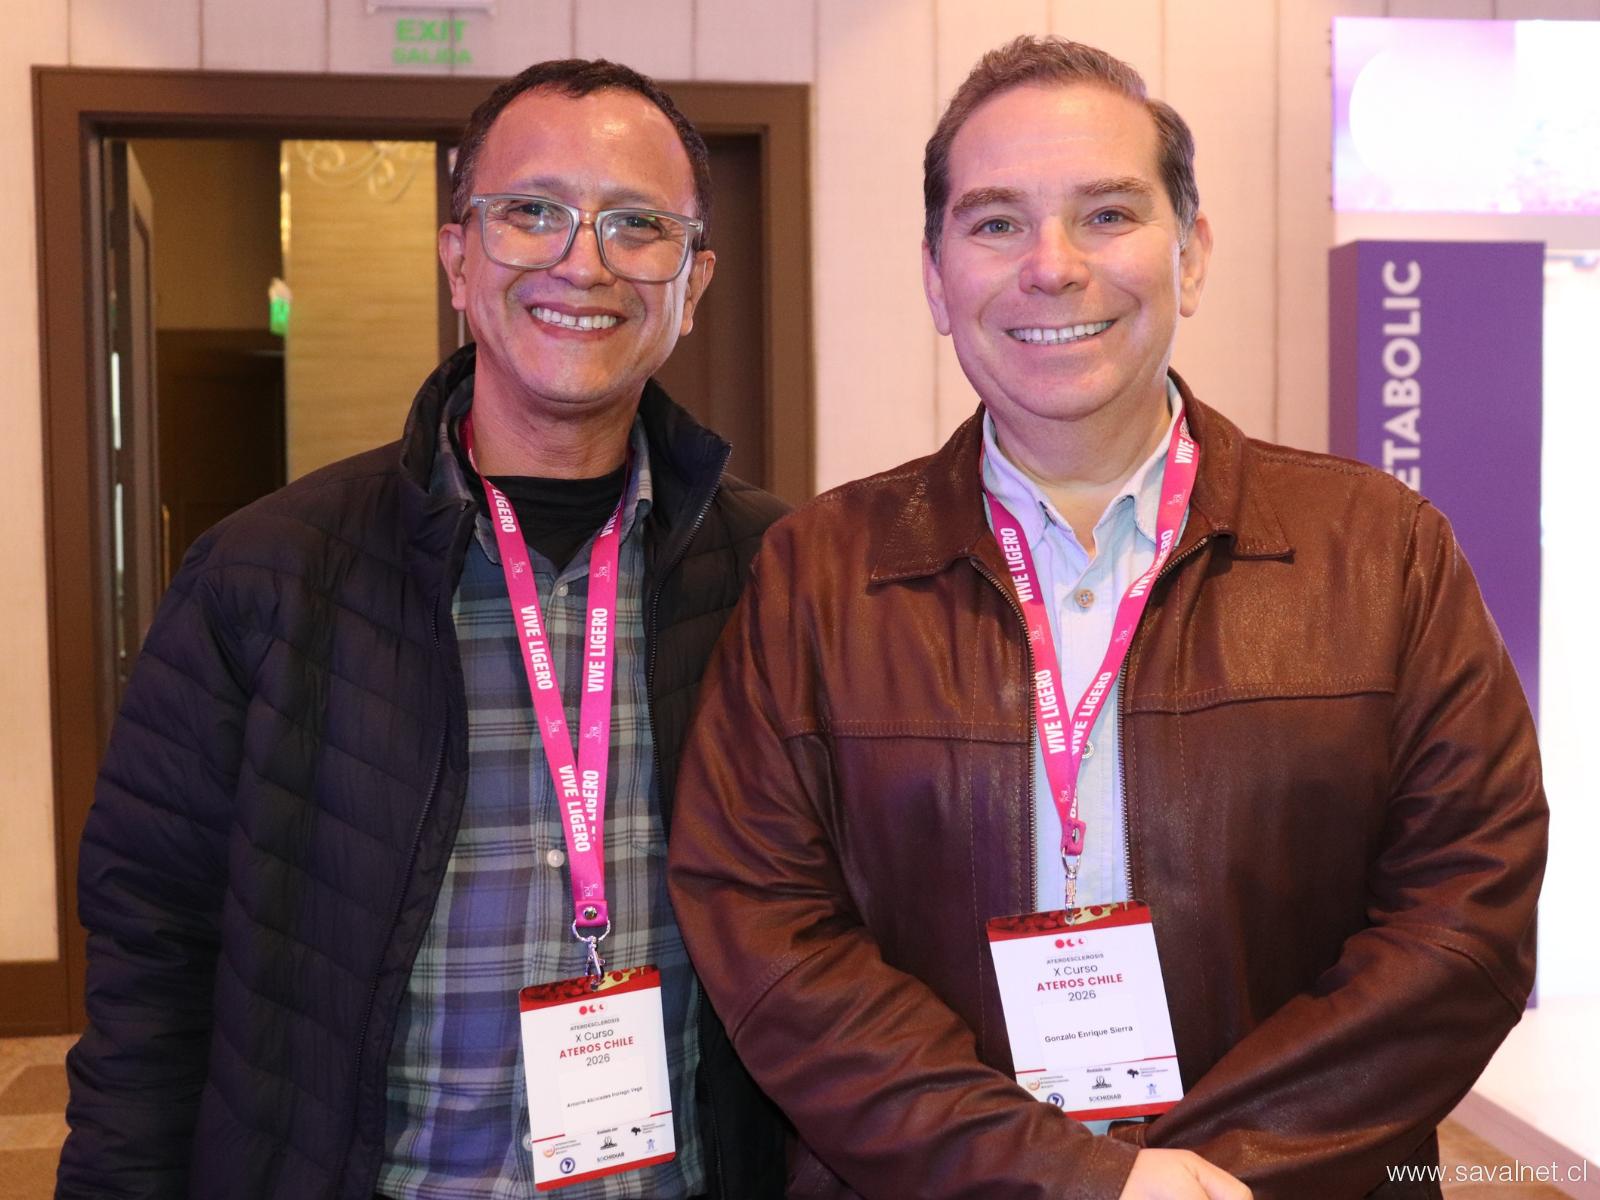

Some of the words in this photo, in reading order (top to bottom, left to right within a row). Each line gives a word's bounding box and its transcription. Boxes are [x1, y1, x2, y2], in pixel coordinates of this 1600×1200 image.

[396, 19, 467, 41] EXIT
[1174, 438, 1194, 464] VIVE
[1000, 528, 1025, 571] LIGERO
[1012, 573, 1034, 602] VIVE
[520, 604, 541, 637] VIVE
[591, 607, 608, 656] LIGERO
[528, 638, 553, 690] LIGERO
[587, 660, 605, 693] VIVE
[1035, 669, 1060, 718] LIGERO
[1079, 671, 1112, 716] LIGERO
[1043, 720, 1067, 755] VIVE
[558, 764, 579, 797] VIVE
[567, 801, 591, 853] LIGERO
[1036, 975, 1085, 992] ATEROS
[1087, 973, 1124, 987] CHILE
[1053, 967, 1061, 977] X
[1063, 964, 1098, 976] Curso
[1067, 989, 1097, 1002] 2026
[559, 1043, 601, 1059] ATEROS
[603, 1035, 634, 1050] CHILE
[575, 1034, 582, 1042] X
[584, 1029, 614, 1041] Curso
[1044, 1032, 1077, 1043] Gonzalo
[1077, 1027, 1108, 1039] Enrique
[1109, 1025, 1134, 1034] Sierra
[586, 1053, 610, 1067] 2026
